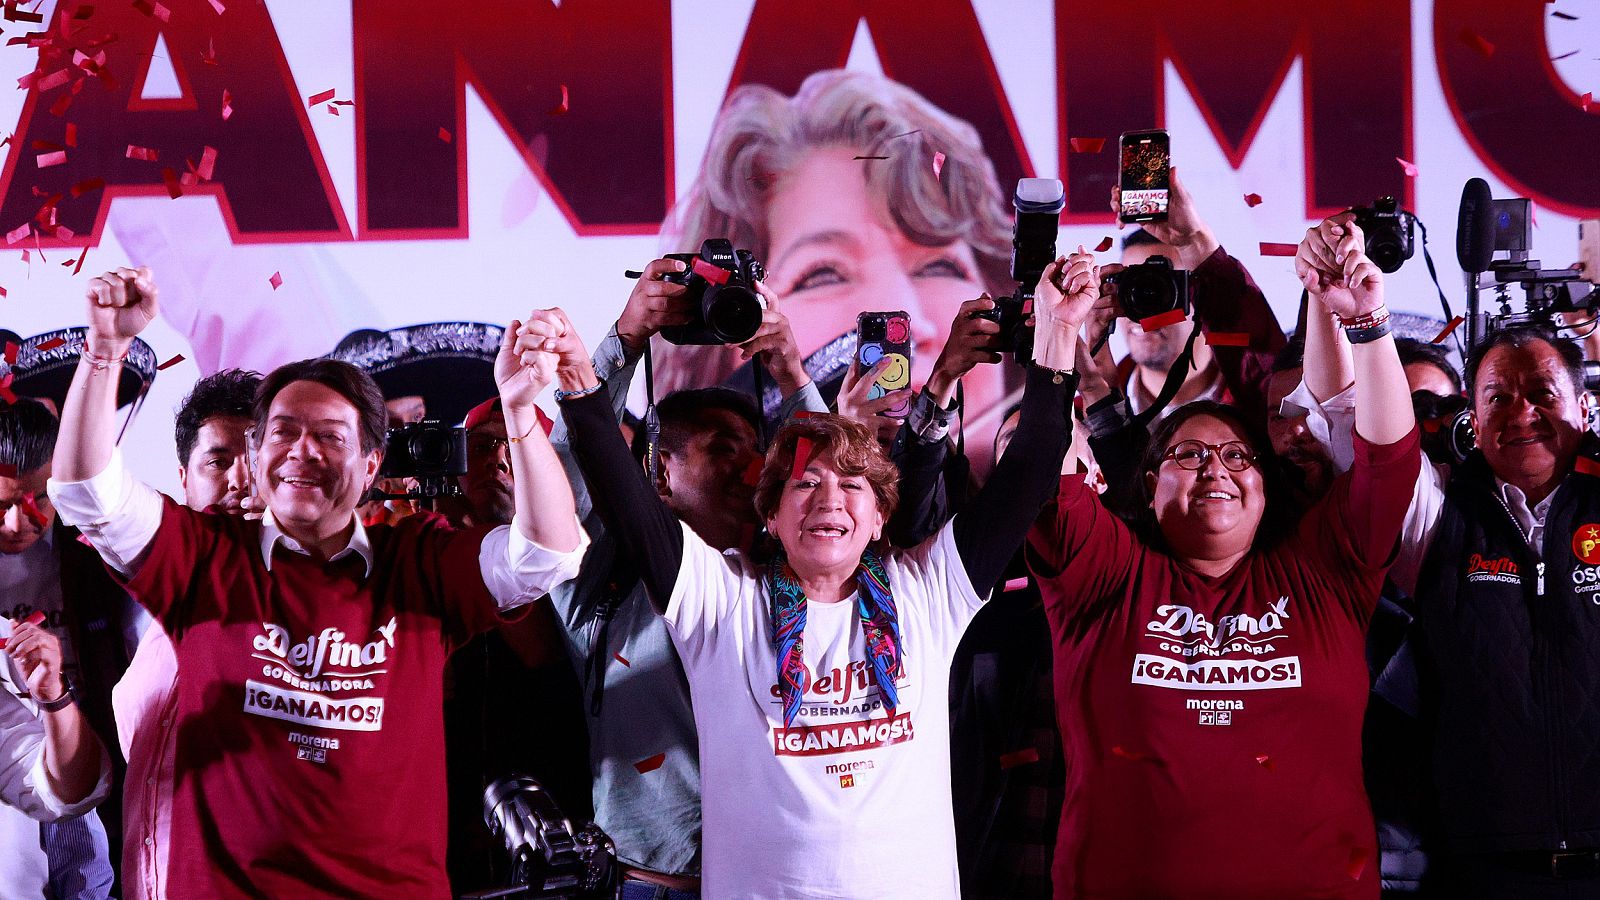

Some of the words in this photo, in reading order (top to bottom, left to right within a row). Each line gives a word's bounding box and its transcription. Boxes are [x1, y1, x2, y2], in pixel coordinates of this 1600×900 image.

[1470, 574, 1521, 585] GOBERNADORA
[252, 622, 388, 679] Delfina
[1159, 642, 1276, 657] GOBERNADORA
[262, 664, 375, 692] GOBERNADORA
[1136, 660, 1297, 684] ¡GANAMOS!
[248, 688, 381, 723] ¡GANAMOS!
[799, 700, 882, 717] OBERNADO
[1186, 698, 1244, 710] morena
[1201, 714, 1213, 723] PT
[288, 731, 340, 750] morena
[777, 718, 910, 752] ¡GANAMOS!
[298, 749, 311, 759] PT
[825, 759, 875, 774] morena
[841, 778, 853, 787] PT
